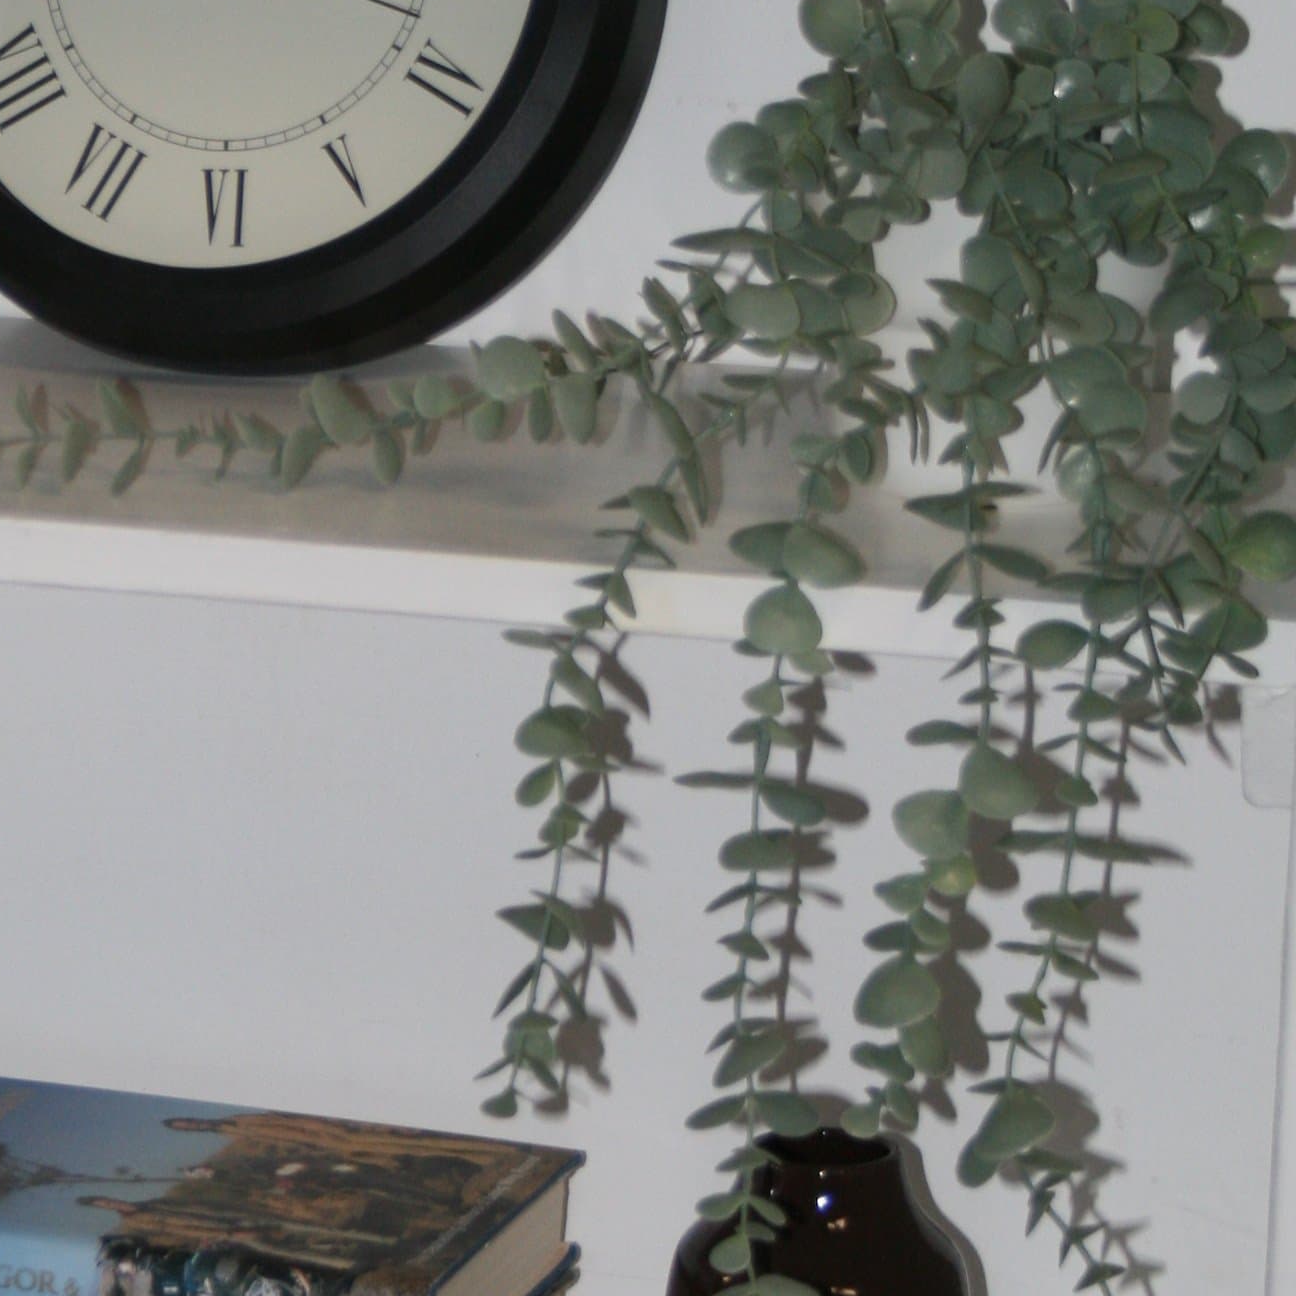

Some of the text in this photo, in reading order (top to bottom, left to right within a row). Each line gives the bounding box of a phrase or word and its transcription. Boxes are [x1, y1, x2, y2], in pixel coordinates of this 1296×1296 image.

[403, 38, 485, 119] IV
[64, 123, 148, 222] VII
[201, 168, 248, 248] VI
[321, 133, 367, 208] V
